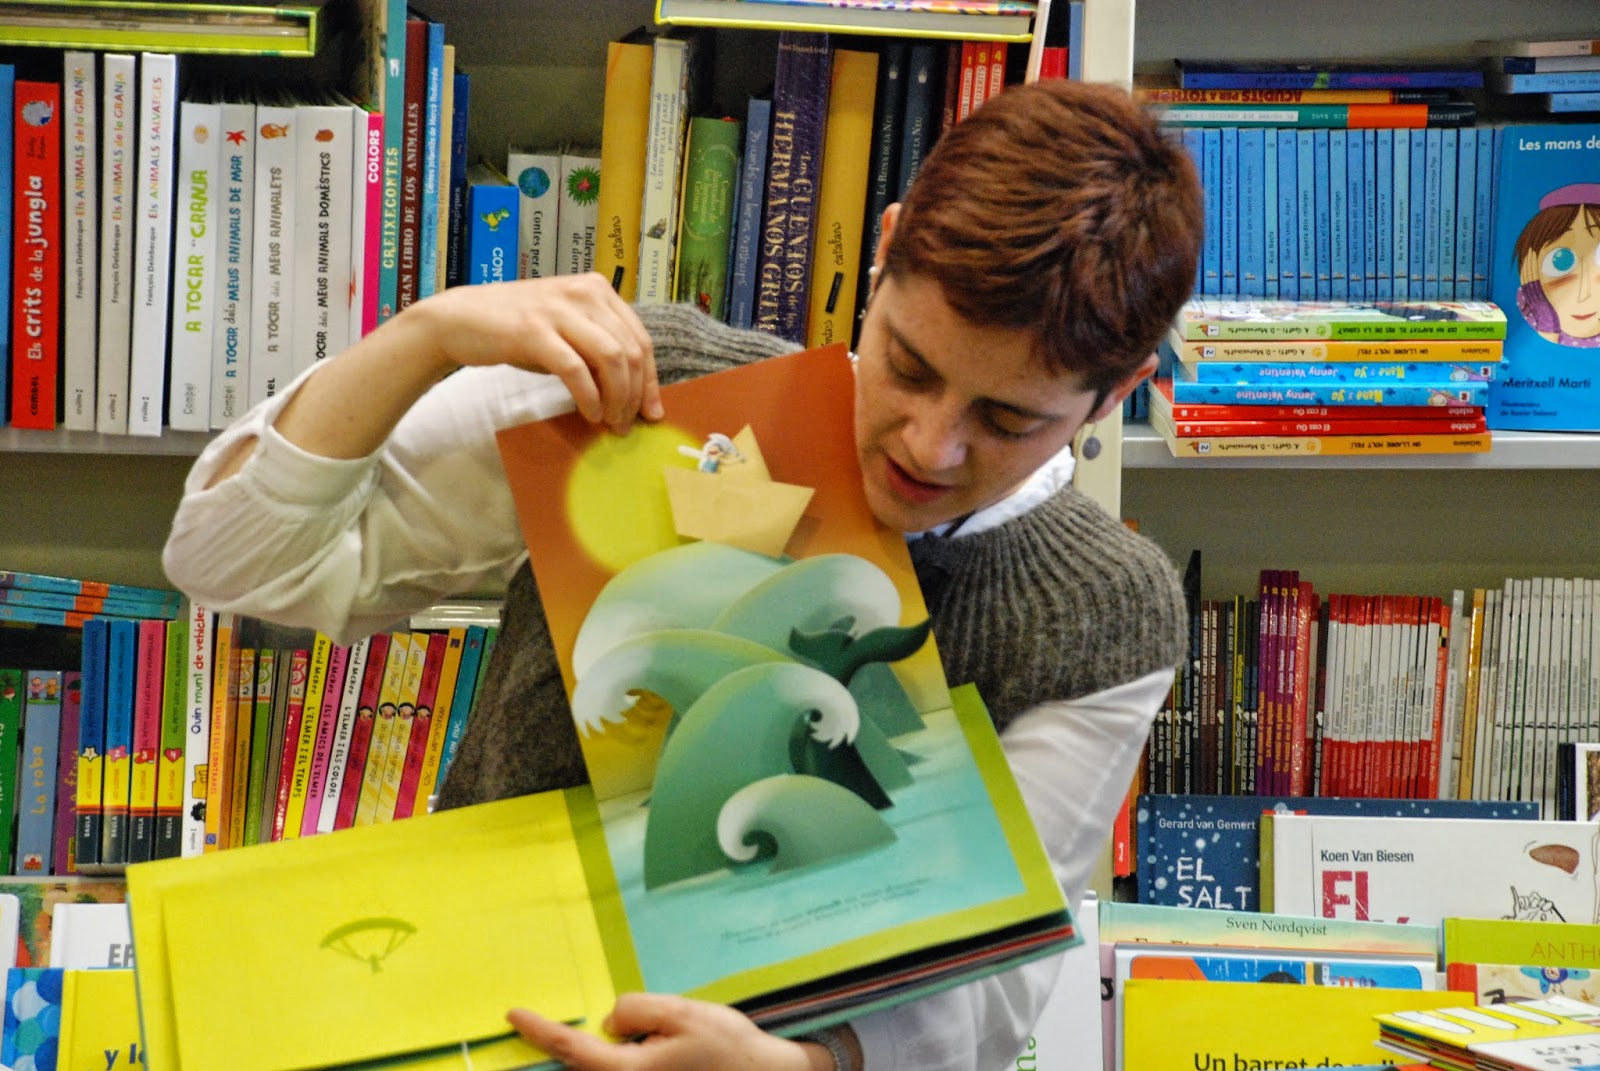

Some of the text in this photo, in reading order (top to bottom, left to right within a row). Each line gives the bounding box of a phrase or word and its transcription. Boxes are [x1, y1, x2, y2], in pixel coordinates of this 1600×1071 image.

[73, 67, 85, 113] GRANJA
[113, 72, 125, 118] GRANJA
[1218, 91, 1239, 100] PER
[1241, 90, 1302, 102] ACUDITS
[75, 128, 84, 142] de
[114, 133, 124, 146] de
[149, 77, 163, 218] Els ANIMALS SALVATGES
[406, 102, 419, 169] ANIMALES
[1519, 138, 1541, 151] Les
[1544, 140, 1582, 150] mans
[231, 155, 243, 182] MAR
[368, 129, 380, 183] COLORS
[74, 145, 85, 198] ANIMALS
[112, 149, 124, 203] ANIMALS
[762, 110, 795, 257] HERMANOS
[230, 187, 241, 202] DE
[270, 166, 282, 237] ANIMALETS
[404, 176, 416, 201] LOS
[23, 175, 49, 248] jungla
[75, 201, 85, 216] Els
[113, 205, 123, 220] Els
[382, 146, 399, 269] CREIXECONTES
[404, 206, 415, 223] DE
[229, 207, 241, 263] ANIMALS
[315, 152, 330, 308] MEUS ANIMALS DOMÈSTICS
[533, 211, 543, 246] Contes
[784, 178, 813, 293] CUENTOS
[32, 249, 44, 262] la
[269, 241, 281, 275] MEUS
[402, 228, 414, 269] LIBRO
[30, 266, 44, 281] de
[186, 255, 203, 312] TOCAR
[227, 268, 240, 301] MEUS
[647, 250, 659, 296] BARKLEM
[21, 287, 42, 337] crits
[787, 295, 799, 310] de
[268, 301, 280, 339] TOCAR
[785, 313, 798, 328] los
[27, 343, 43, 360] Els
[226, 327, 238, 364] TOCAR
[1259, 368, 1305, 377] Valentine
[1502, 376, 1554, 388] Meritxell
[1235, 391, 1283, 400] Valentine
[1448, 408, 1474, 416] edebé
[1450, 423, 1476, 431] edebé
[315, 640, 325, 664] David
[353, 641, 363, 665] David
[310, 666, 321, 695] McKee
[327, 666, 337, 694] McKee
[347, 667, 358, 695] McKee
[191, 654, 204, 734] Quin munt de
[323, 704, 332, 717] ELS
[338, 706, 352, 741] L'ELMER
[301, 706, 315, 745] L'ELMER
[318, 720, 330, 748] AMICS
[451, 719, 462, 739] RUC
[299, 755, 307, 765] EL
[316, 752, 325, 762] DE
[334, 749, 344, 763] ELS
[29, 745, 47, 814] La roba
[292, 767, 305, 799] TEMPS
[310, 764, 324, 799] L'ELMER
[326, 765, 339, 799] COLORS
[1159, 818, 1256, 830] Gerard van Gemert
[1177, 857, 1215, 881] EL
[1321, 850, 1414, 862] Koen Van Biesen
[1177, 885, 1252, 910] SALT
[1226, 917, 1328, 939] Sven Nordqvist
[104, 1049, 119, 1071] y
[1194, 1053, 1226, 1071] Un
